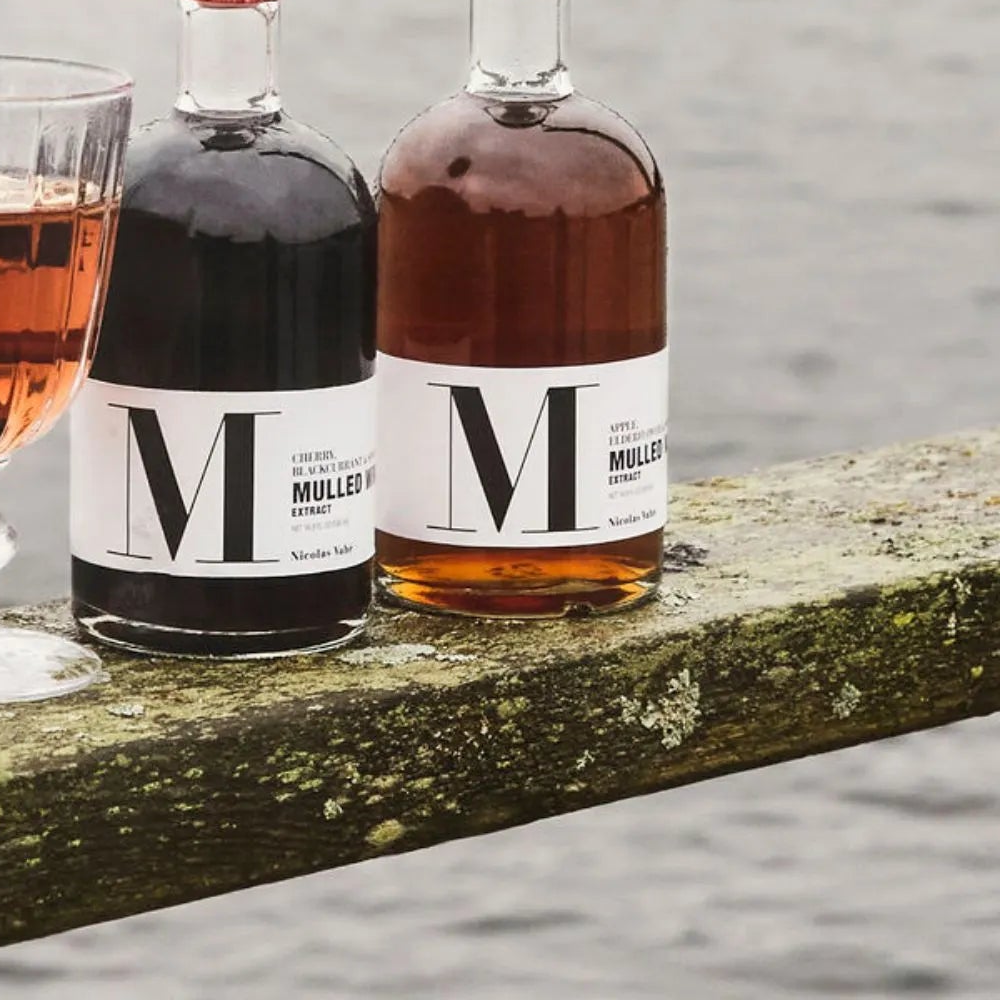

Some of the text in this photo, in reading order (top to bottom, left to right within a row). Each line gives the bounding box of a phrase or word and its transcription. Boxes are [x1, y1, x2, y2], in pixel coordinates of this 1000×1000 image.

[427, 382, 600, 534] M
[609, 439, 663, 472] MULLED
[107, 402, 282, 562] M
[292, 472, 362, 504] MULLED
[608, 471, 641, 485] EXTRACT
[291, 504, 332, 518] EXTRACT
[290, 548, 331, 561] Nicolas
